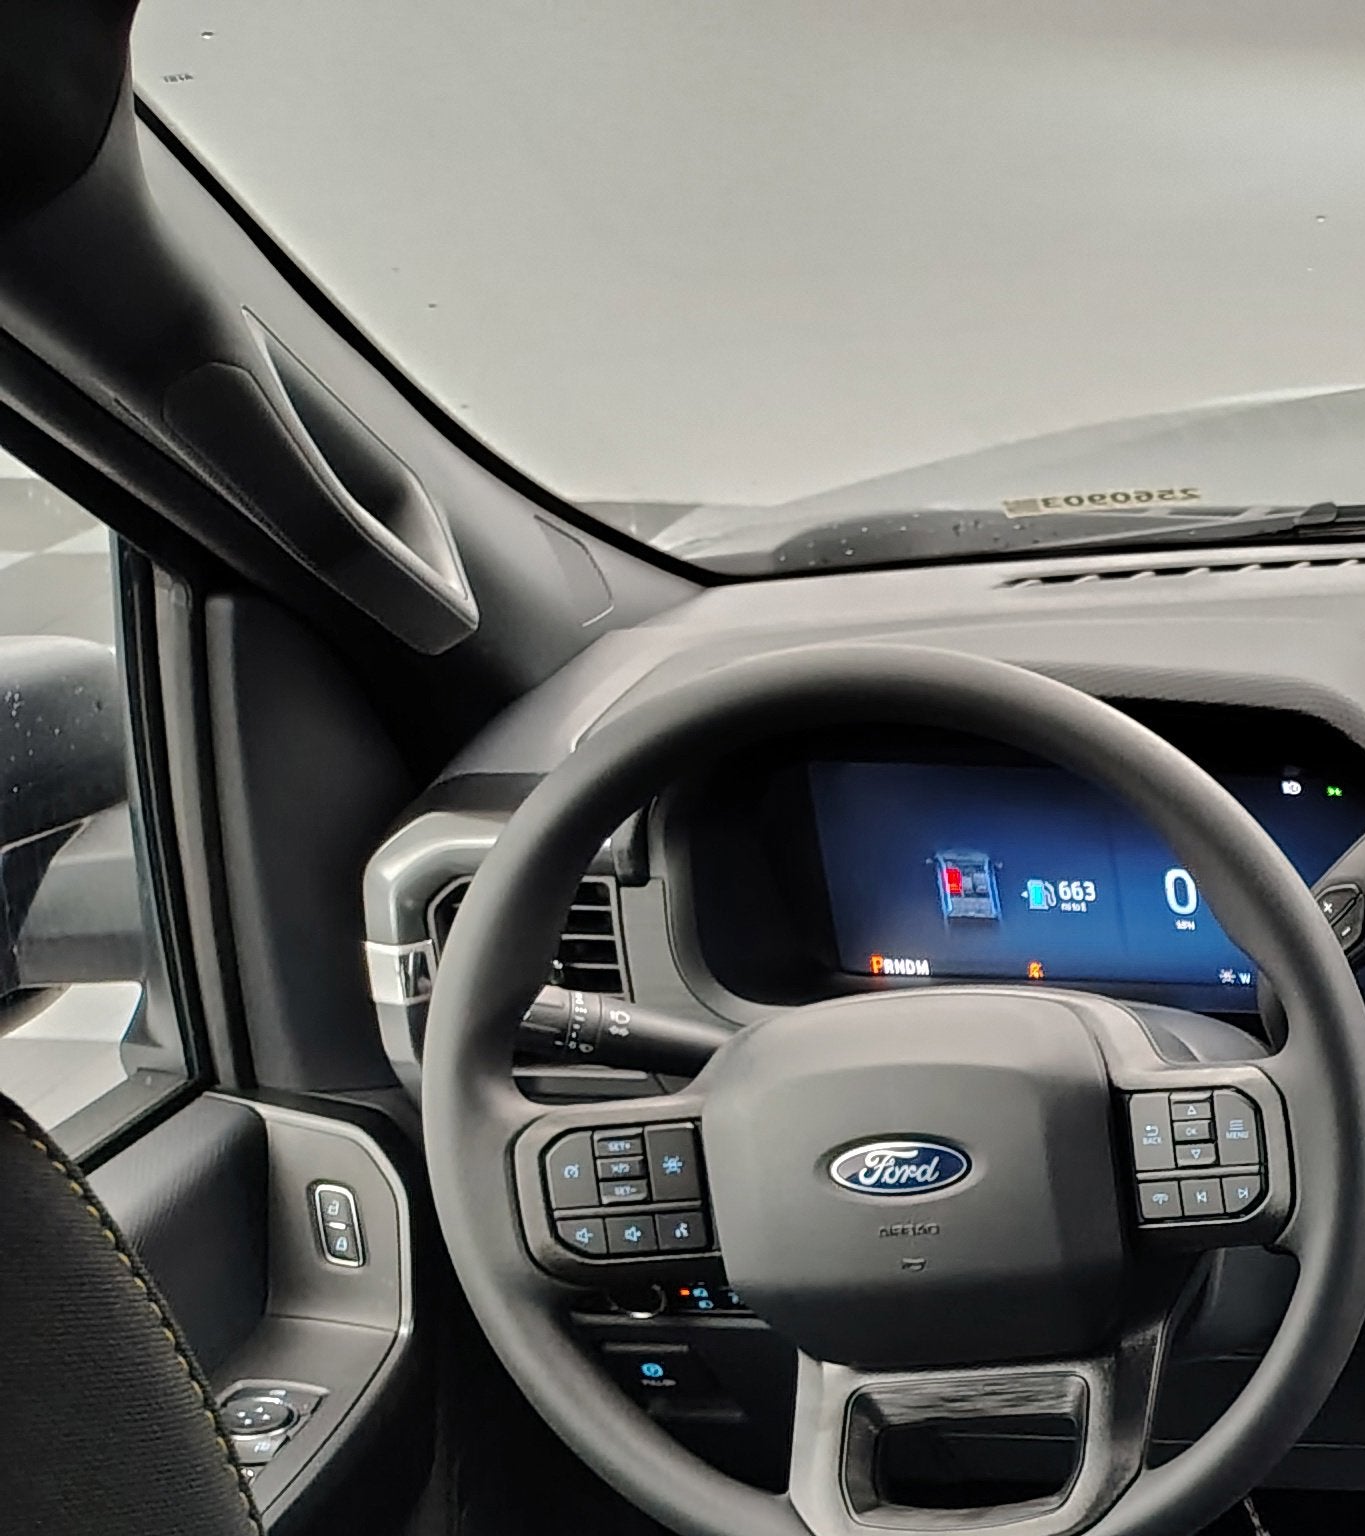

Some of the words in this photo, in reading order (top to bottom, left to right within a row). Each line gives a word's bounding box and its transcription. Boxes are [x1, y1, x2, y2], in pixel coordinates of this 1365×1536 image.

[1058, 880, 1097, 902] 663
[1164, 868, 1198, 915] 0
[1143, 1136, 1162, 1145] BACK
[1225, 1131, 1249, 1139] MENU
[858, 1149, 940, 1186] Ford
